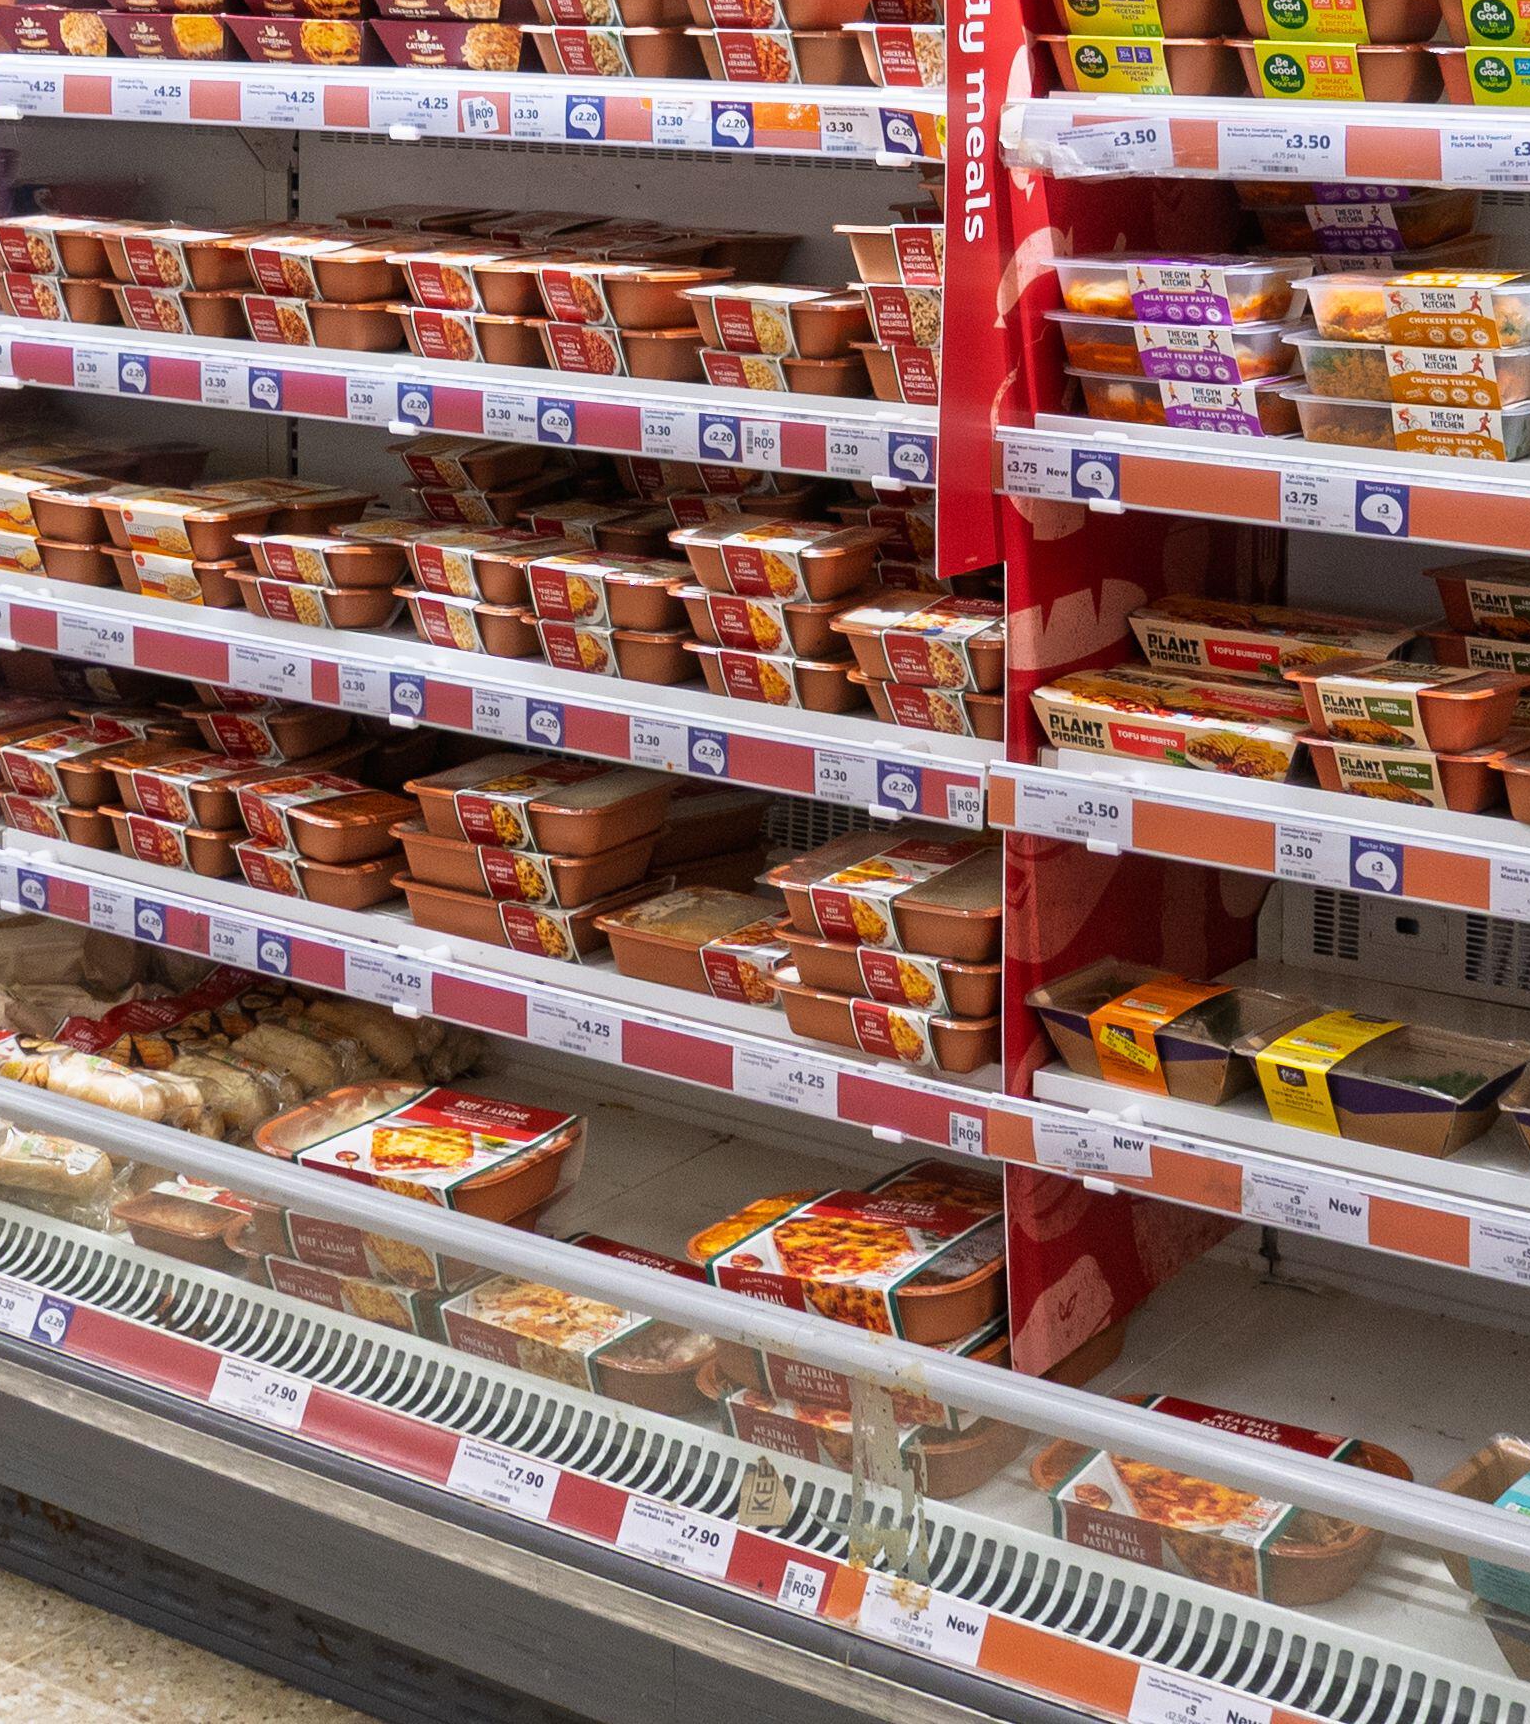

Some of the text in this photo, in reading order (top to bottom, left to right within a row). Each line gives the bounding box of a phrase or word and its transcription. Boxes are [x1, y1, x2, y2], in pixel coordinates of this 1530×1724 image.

[30, 80, 56, 93] £4.25
[418, 96, 448, 110] £4.25
[475, 106, 493, 118] R09
[514, 109, 539, 120] £3.30
[574, 112, 598, 122] £2.20
[1286, 135, 1331, 150] £3.50
[964, 67, 991, 243] meals
[1143, 294, 1216, 303] MEAT FEAST PASTA
[1423, 300, 1455, 308] KITCHEN
[1437, 293, 1454, 301] GYM
[1450, 317, 1476, 325] TIKKA
[486, 408, 511, 421] £3.30
[518, 414, 536, 424] New
[754, 436, 775, 451] R09
[1047, 467, 1069, 478] New
[1284, 491, 1318, 507] £3.75
[1213, 645, 1273, 662] TOFU BURRITO
[1049, 714, 1104, 737] PLANT
[1051, 731, 1105, 749] PIONEERS
[957, 799, 980, 813] R09
[1077, 801, 1119, 820] £3.50
[788, 1071, 825, 1090] £4.25
[455, 1100, 531, 1121] BEEF LASAGNE
[957, 1126, 981, 1142] R09
[1113, 1136, 1145, 1152] New
[1328, 1197, 1363, 1217] New
[264, 1383, 297, 1402] £7.90
[681, 1527, 720, 1548] £7.90
[1088, 1522, 1141, 1546] MEATBALL
[1082, 1534, 1147, 1560] PASTA BAKE
[792, 1581, 816, 1598] R09
